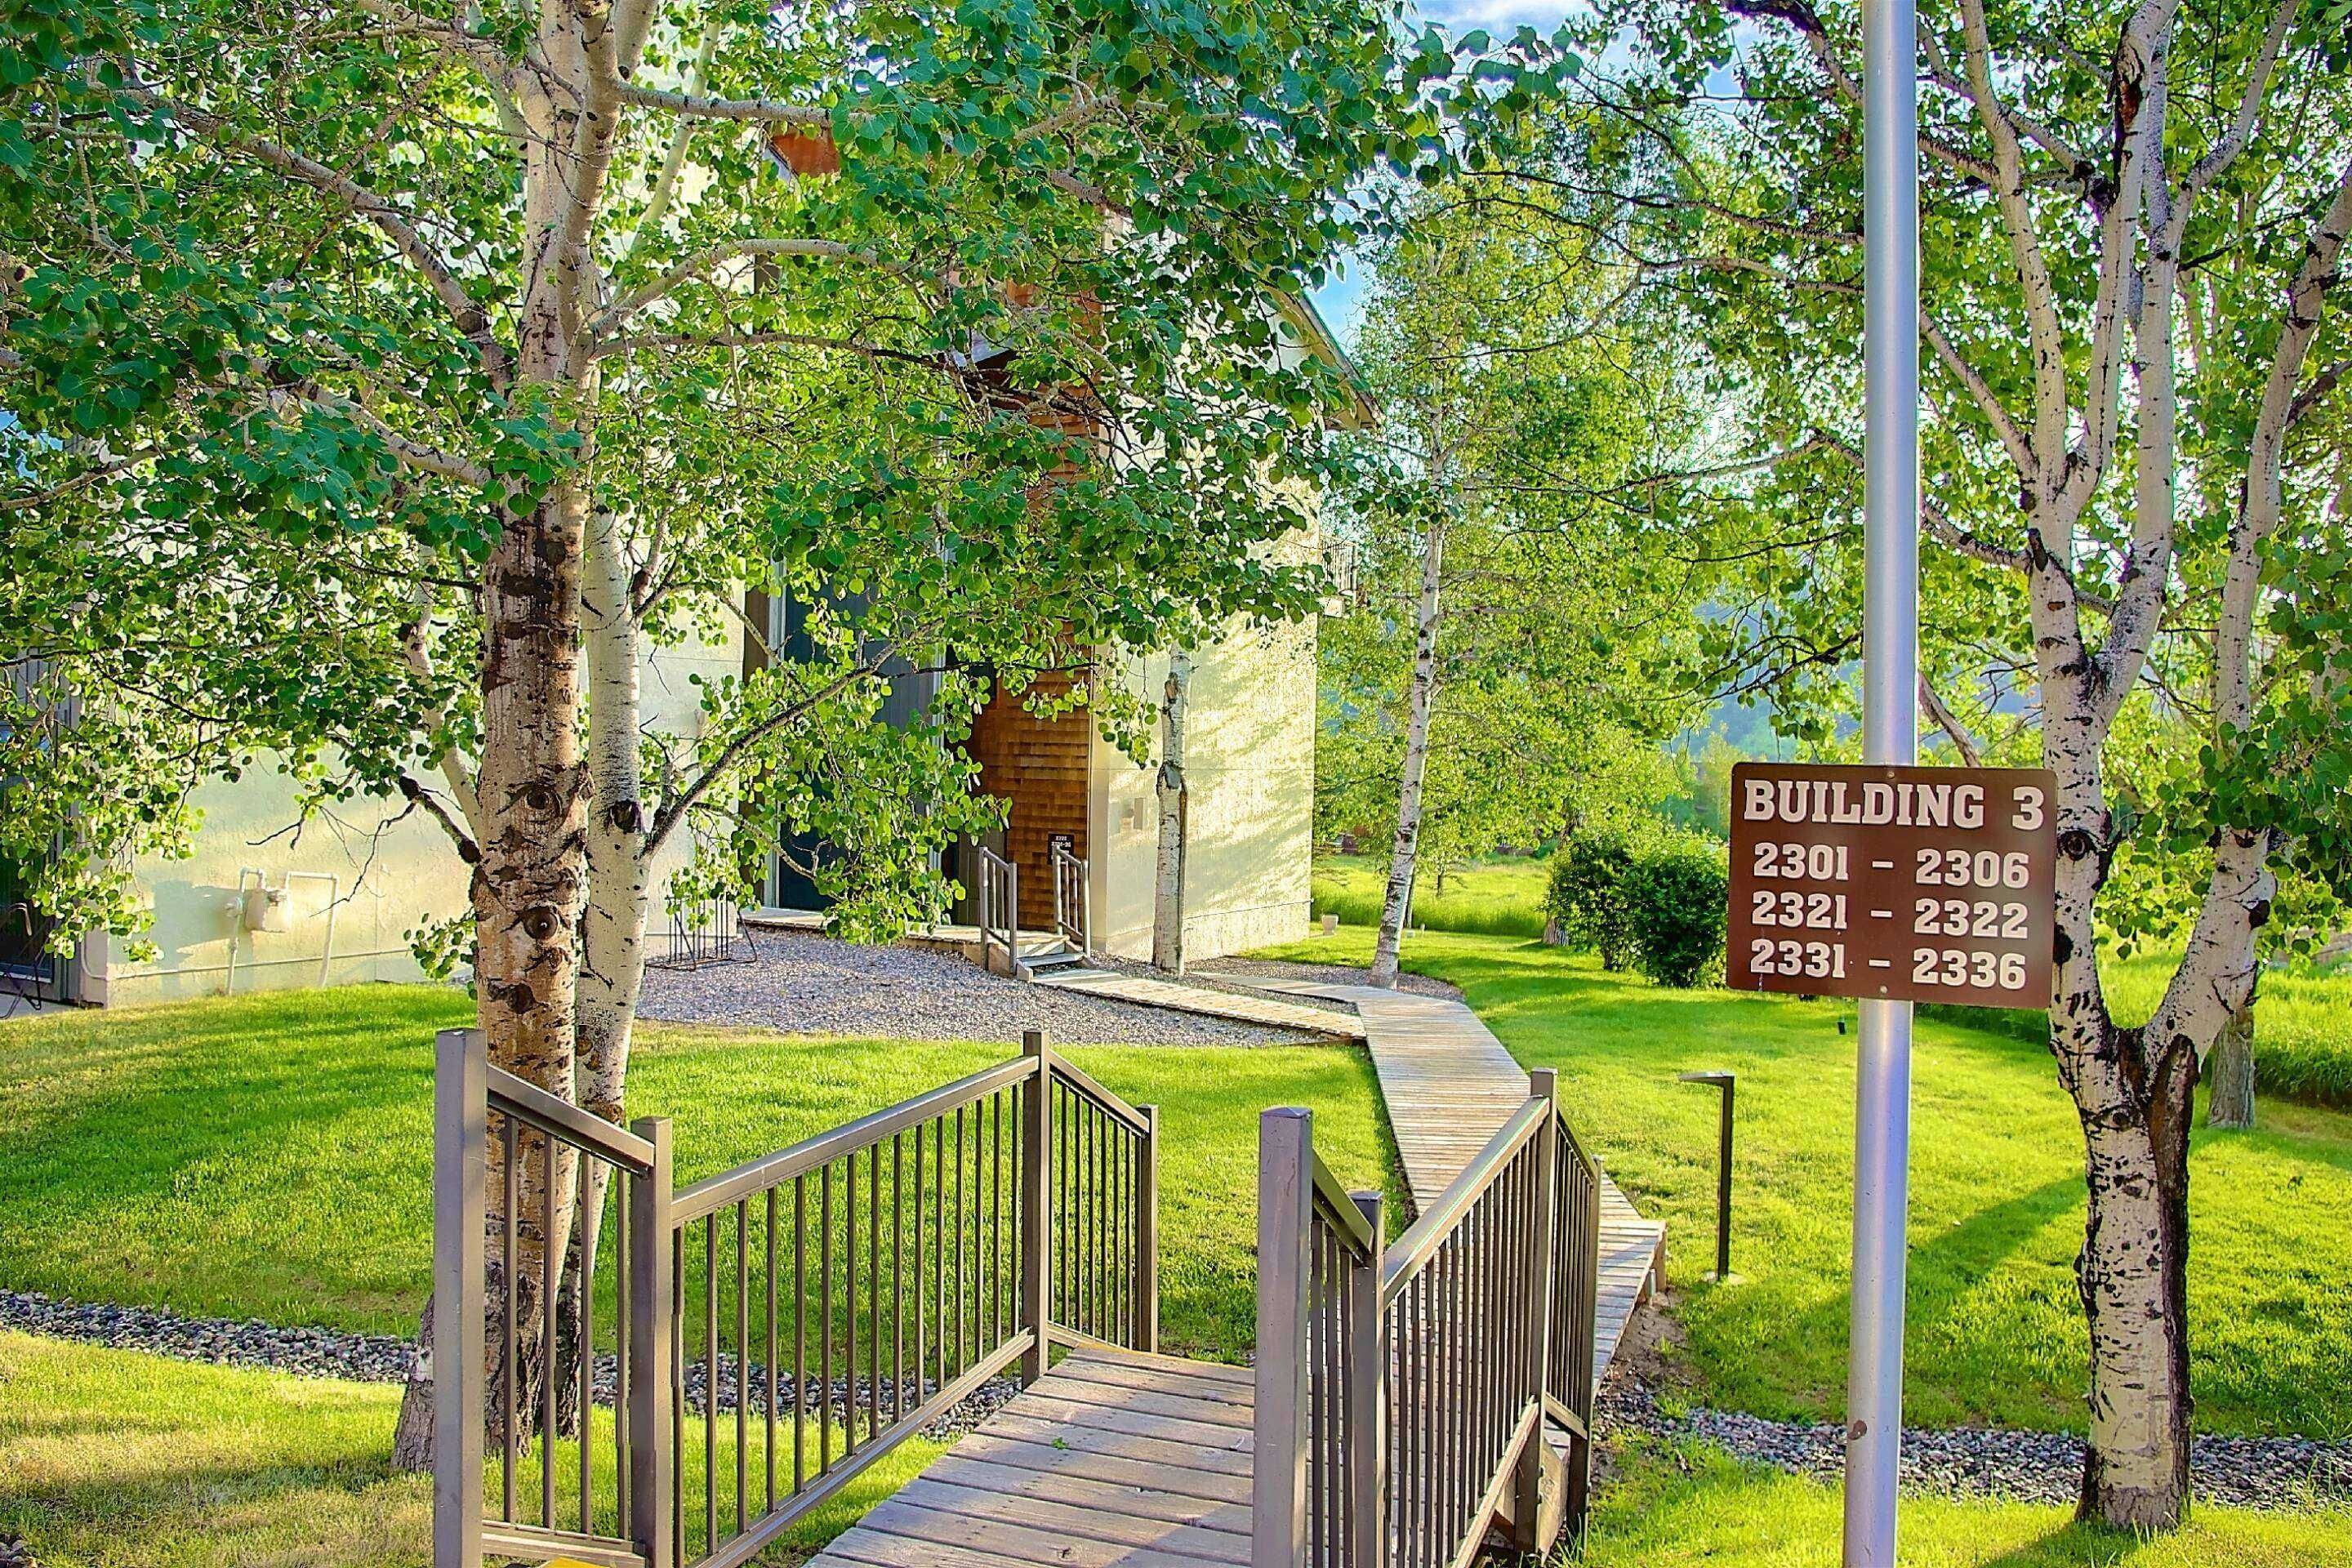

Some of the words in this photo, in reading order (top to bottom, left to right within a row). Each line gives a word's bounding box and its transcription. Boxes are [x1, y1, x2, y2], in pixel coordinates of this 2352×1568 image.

[1744, 779, 1984, 829] BUILDING
[2011, 786, 2044, 831] 3
[1753, 842, 1849, 880] 2301
[1916, 849, 2029, 889] 2306
[1752, 890, 1847, 929] 2321
[1870, 910, 1892, 918] -
[1913, 898, 2029, 939] 2322
[1750, 938, 1846, 978] 2331
[1913, 947, 2026, 990] 2336
